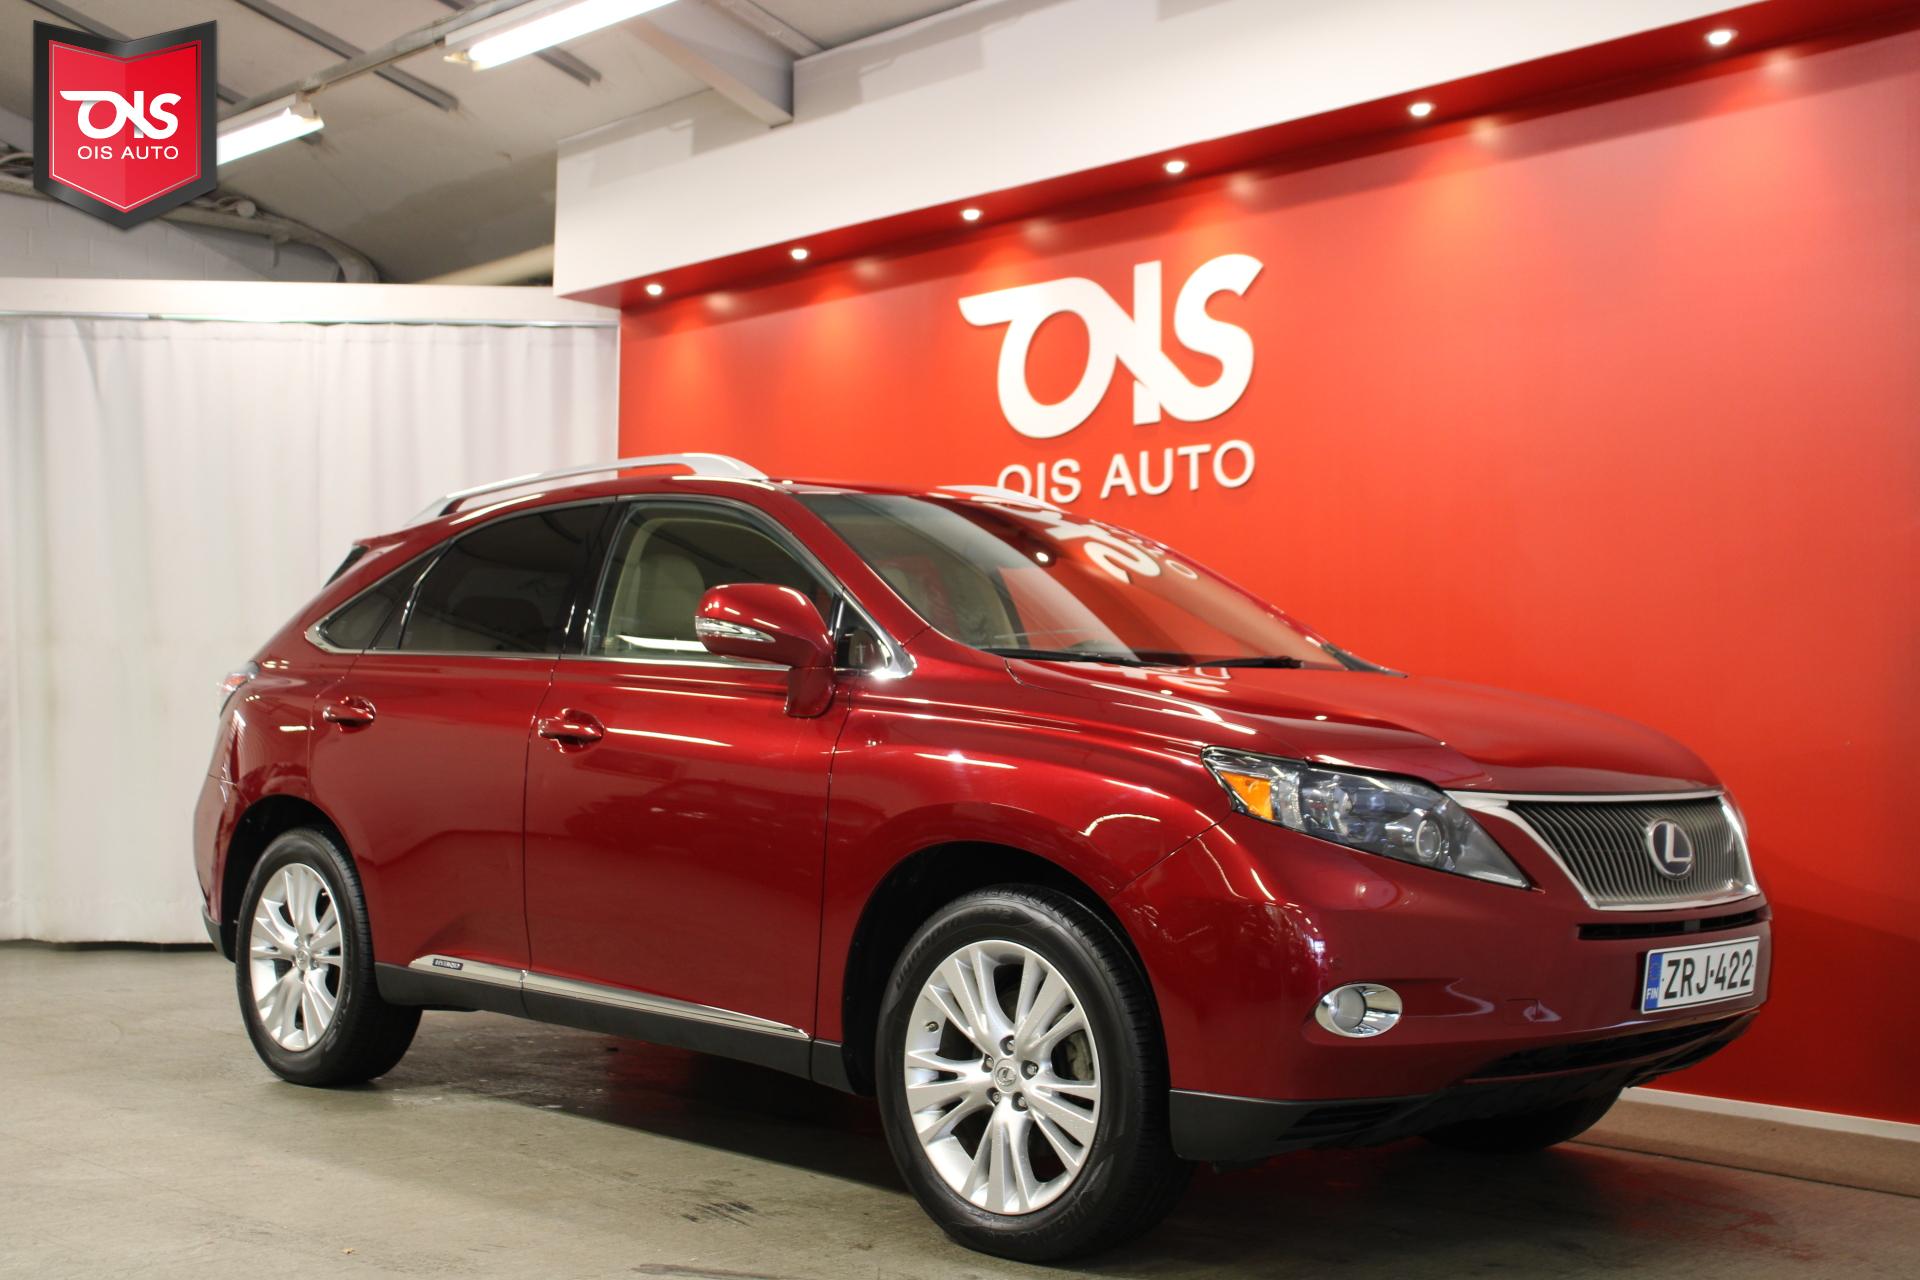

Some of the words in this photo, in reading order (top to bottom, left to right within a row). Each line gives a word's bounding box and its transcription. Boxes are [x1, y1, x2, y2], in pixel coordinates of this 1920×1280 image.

[958, 253, 1264, 439] OIS
[997, 458, 1082, 504] OIS
[1100, 440, 1256, 499] AUTO
[1646, 987, 1659, 999] FIN
[1664, 949, 1754, 1000] ZRJ-422
